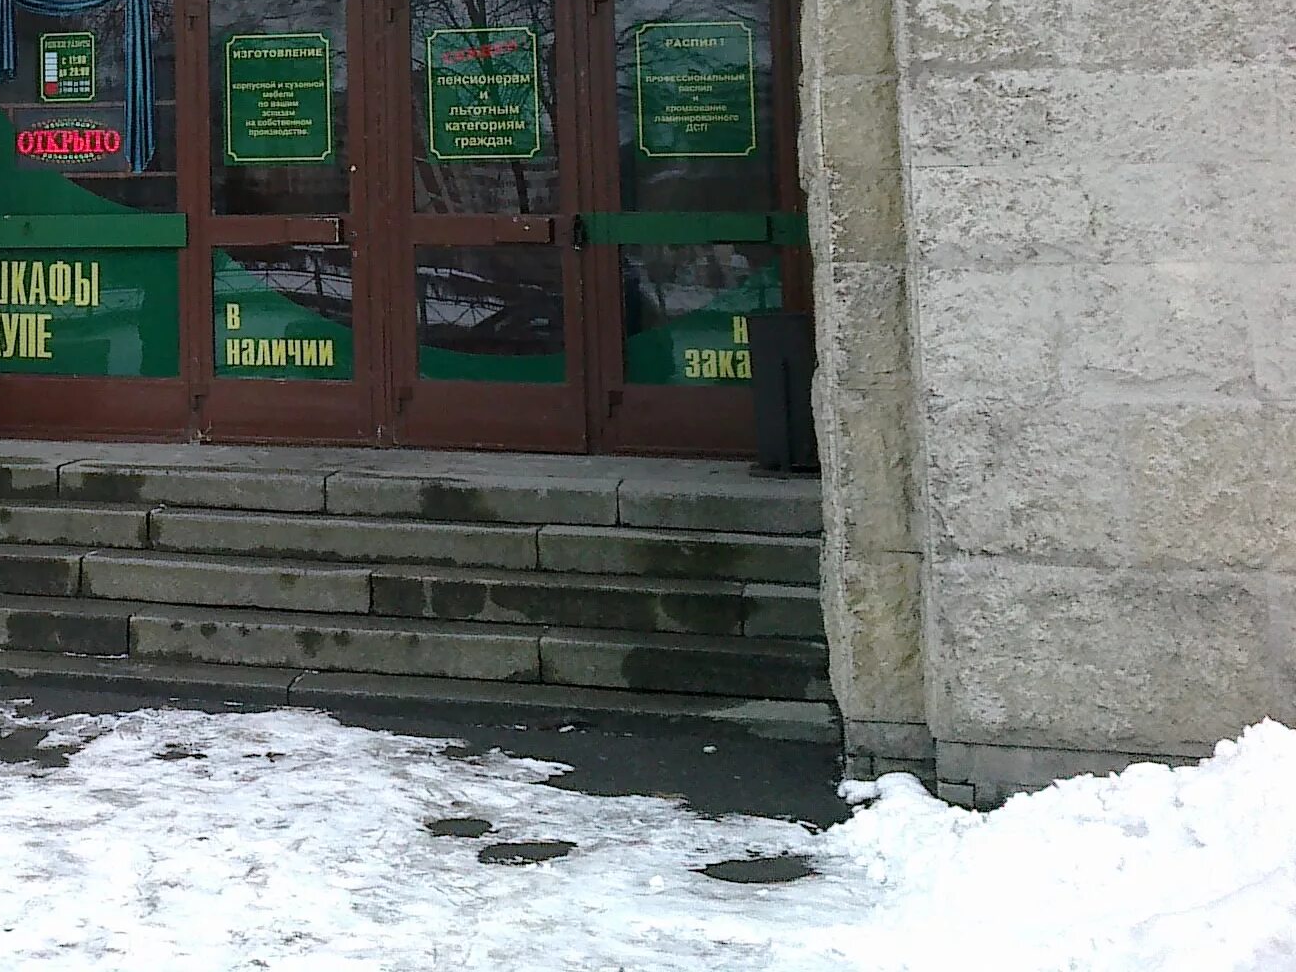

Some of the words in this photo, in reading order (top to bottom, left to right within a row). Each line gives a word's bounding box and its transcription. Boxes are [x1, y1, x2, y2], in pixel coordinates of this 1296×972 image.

[233, 48, 324, 59] ИЗГОТОВЛЕНИЕ
[437, 75, 531, 86] пенсионерам
[480, 91, 488, 100] и
[449, 105, 520, 116] льготным
[445, 119, 526, 132] категориям
[685, 123, 708, 132] ДСП
[17, 129, 121, 154] ОТКРЫТО
[454, 135, 513, 149] граждан
[226, 338, 334, 366] наличии
[684, 349, 752, 379] зака
